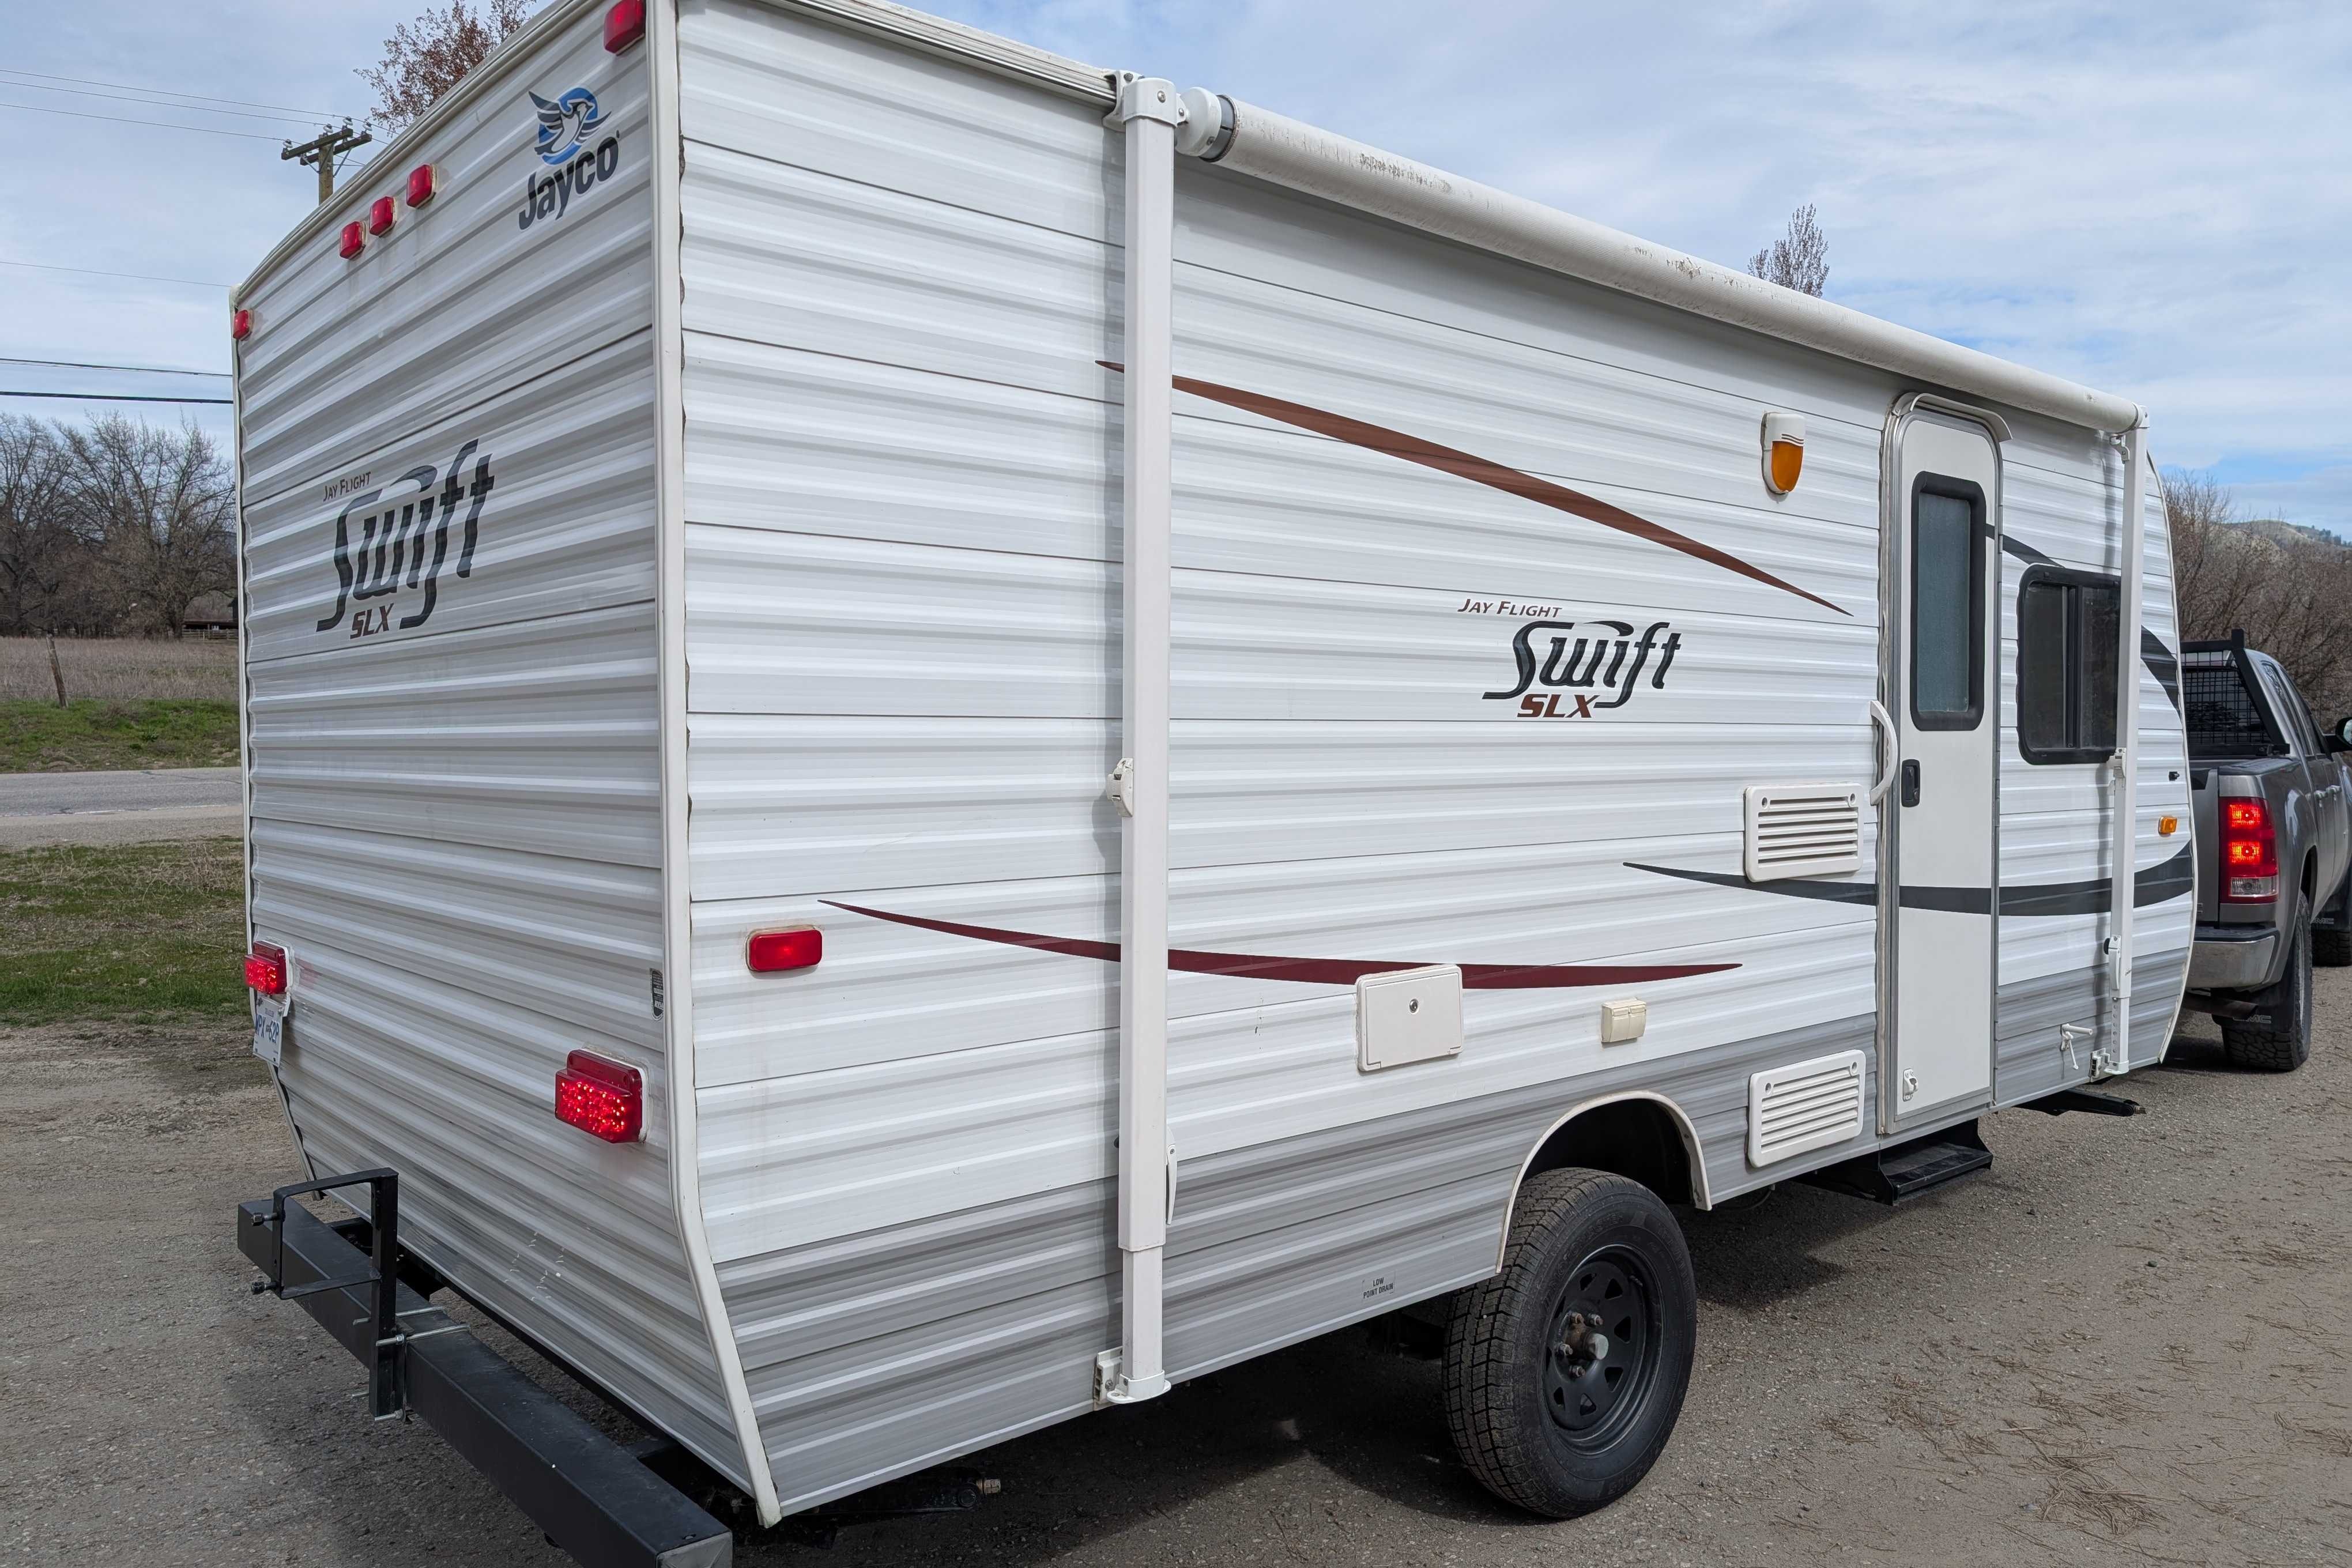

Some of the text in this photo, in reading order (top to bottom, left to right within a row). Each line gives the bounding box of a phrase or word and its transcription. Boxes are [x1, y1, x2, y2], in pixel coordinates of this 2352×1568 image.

[519, 136, 619, 230] Jayco
[323, 472, 371, 502] JAY FLIGHT
[316, 438, 495, 632] Swift
[350, 603, 394, 639] SLX
[1457, 598, 1562, 618] JAY FLIGHT
[1482, 620, 1682, 708] Swift
[1517, 693, 1600, 718] SLX
[1363, 1283, 1393, 1299] POINT DRAIN
[1373, 1277, 1384, 1287] LOW
